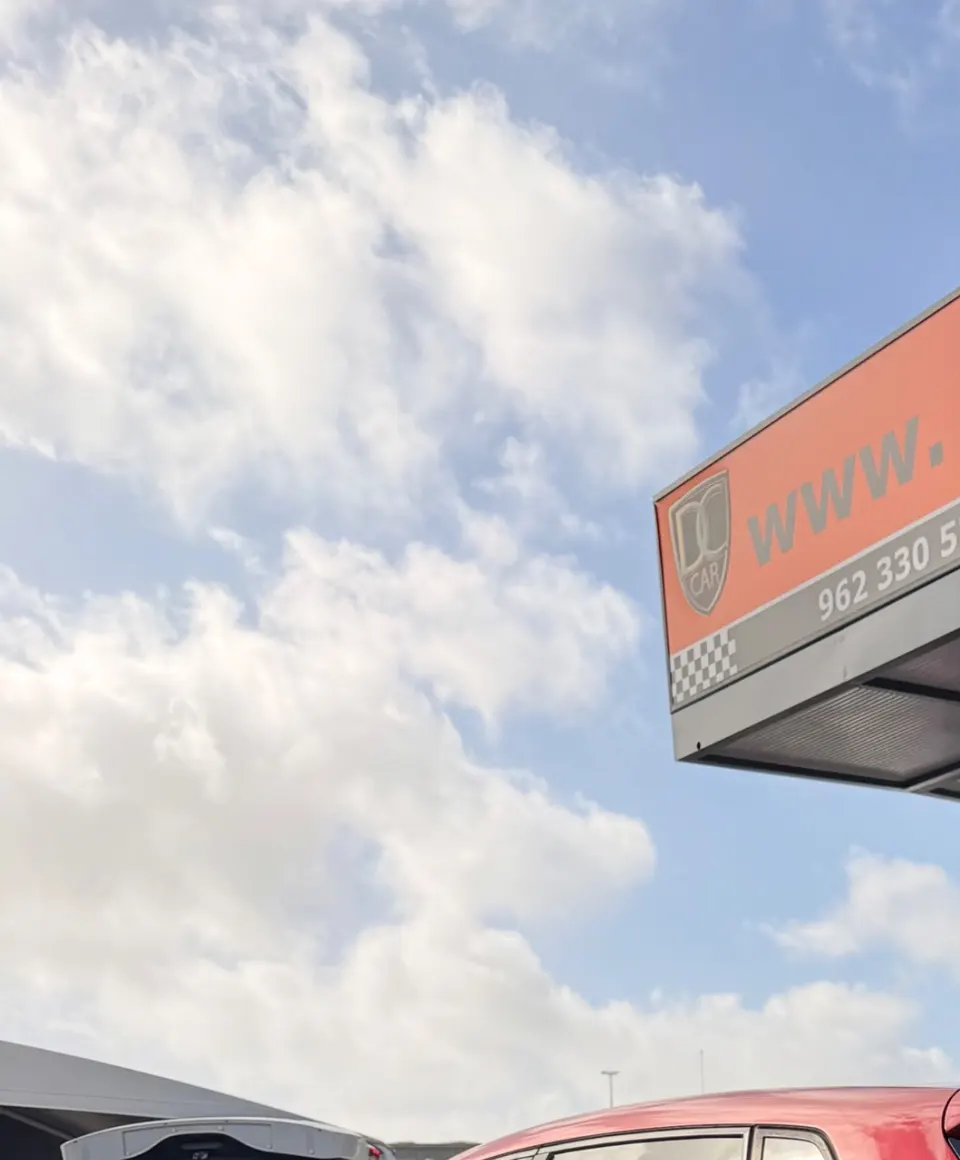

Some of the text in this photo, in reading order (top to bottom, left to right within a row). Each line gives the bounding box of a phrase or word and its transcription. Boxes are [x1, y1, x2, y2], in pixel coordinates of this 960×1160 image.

[689, 563, 722, 596] CAR
[819, 570, 868, 621] 962
[877, 535, 929, 592] 330
